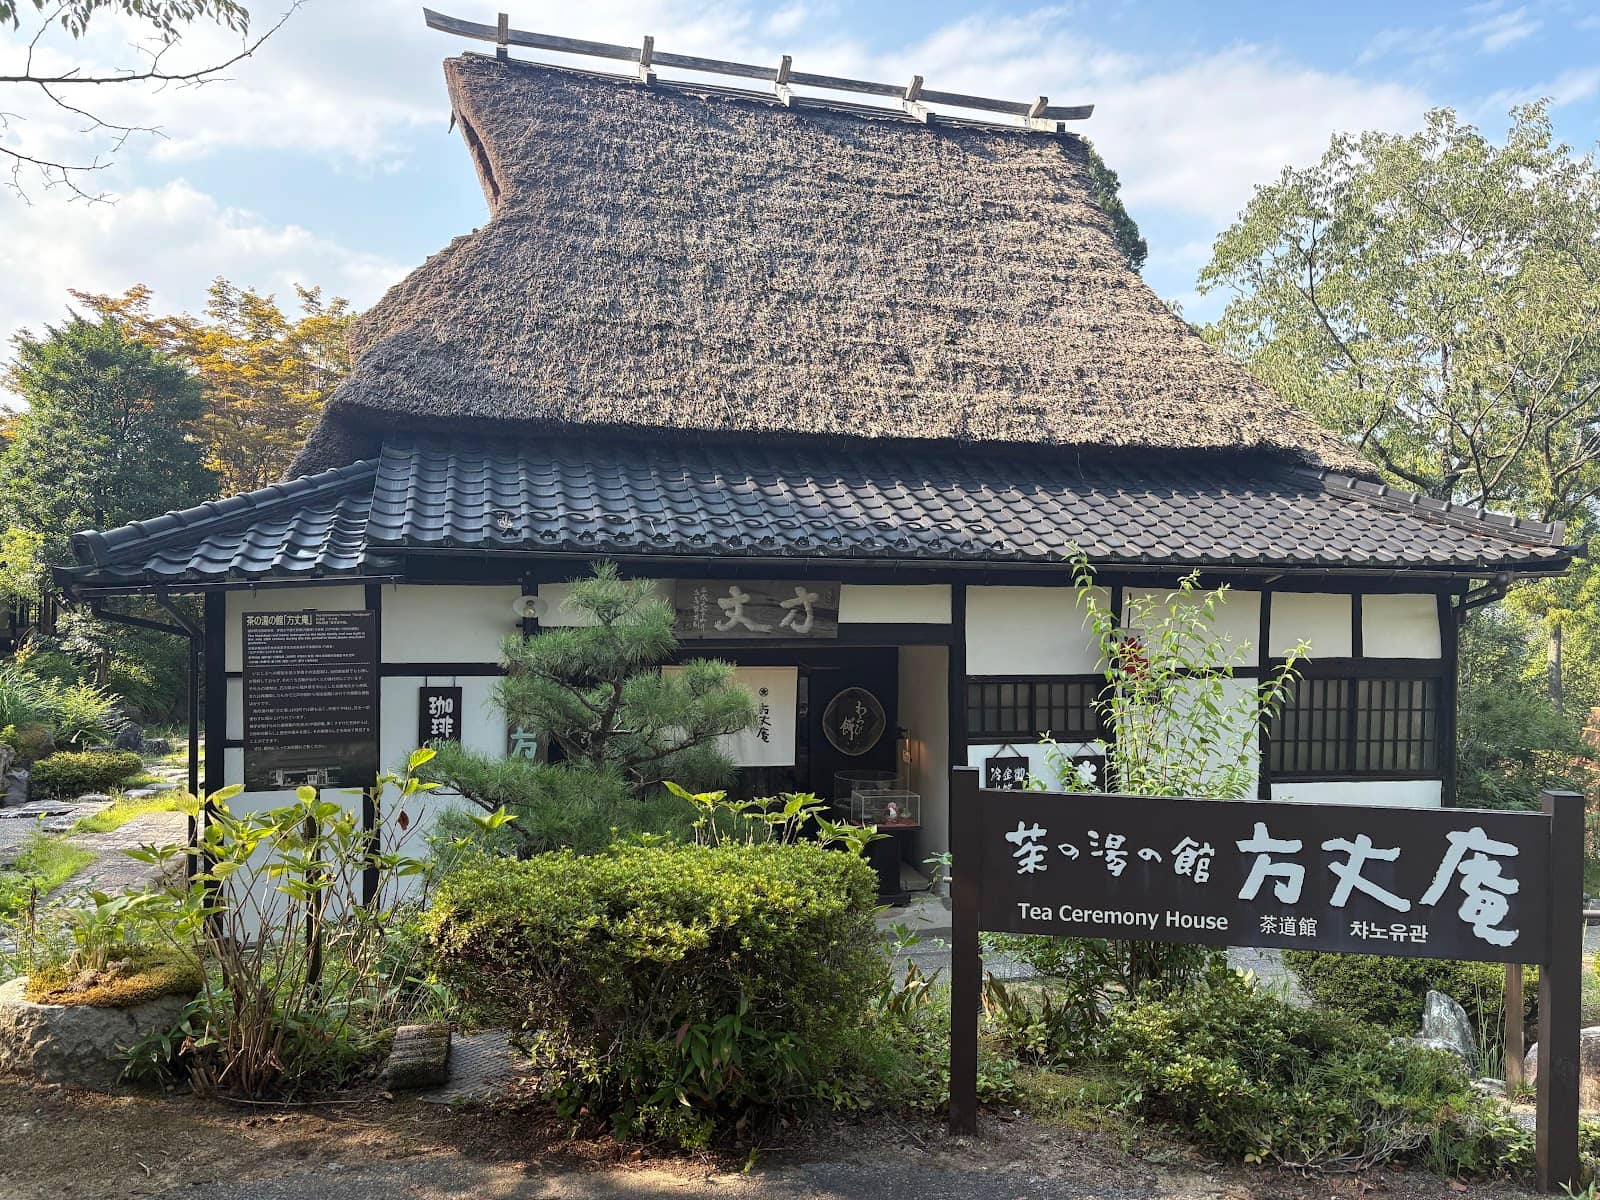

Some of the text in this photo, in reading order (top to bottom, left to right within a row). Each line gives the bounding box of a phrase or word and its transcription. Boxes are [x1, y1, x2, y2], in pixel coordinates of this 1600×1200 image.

[1005, 820, 1520, 947] 茶の湯の館 方丈庵
[1017, 902, 1229, 930] Tea Ceremony House
[1260, 915, 1318, 937] 茶道館
[1350, 920, 1429, 943] 챠노유관
